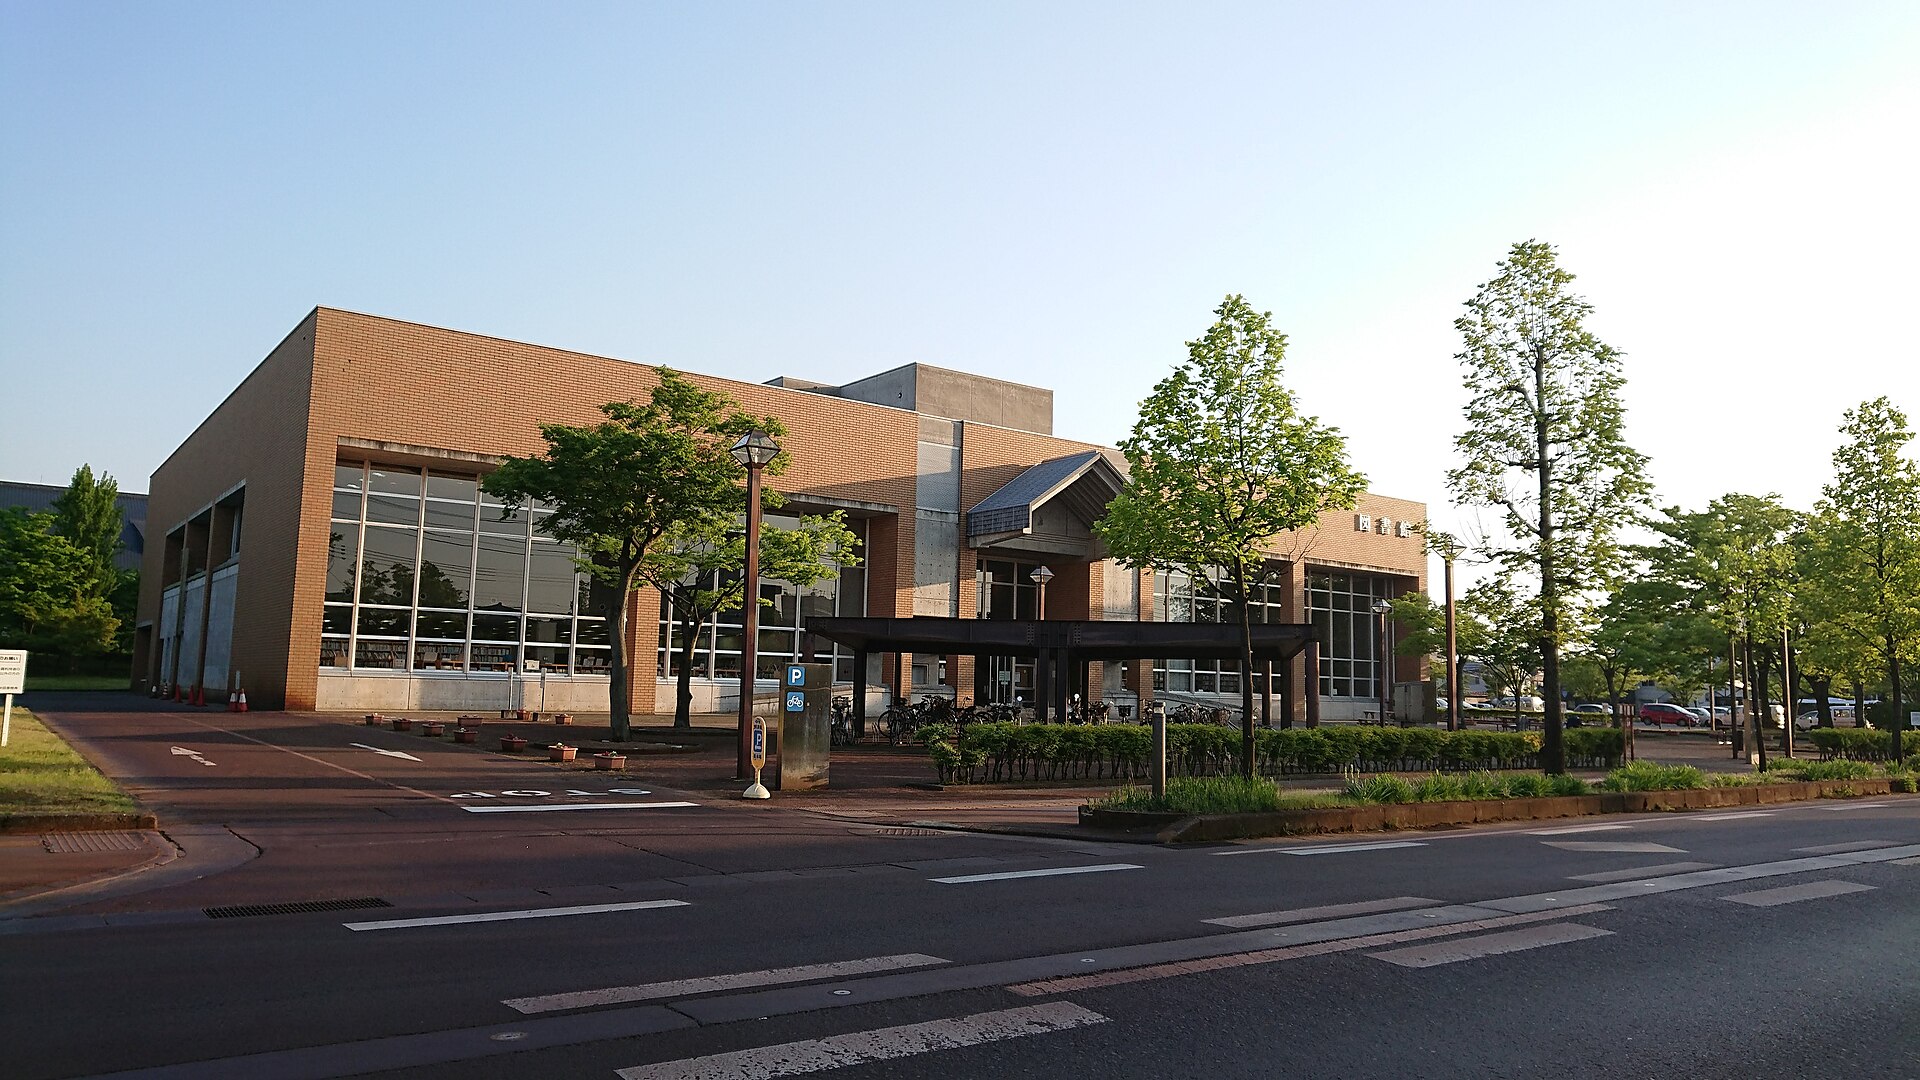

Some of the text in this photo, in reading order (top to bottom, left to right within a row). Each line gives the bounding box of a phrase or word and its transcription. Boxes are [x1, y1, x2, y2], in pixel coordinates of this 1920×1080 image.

[1355, 513, 1411, 538] 図書館
[791, 668, 802, 683] P
[756, 733, 762, 746] P
[450, 788, 652, 798] STOP
